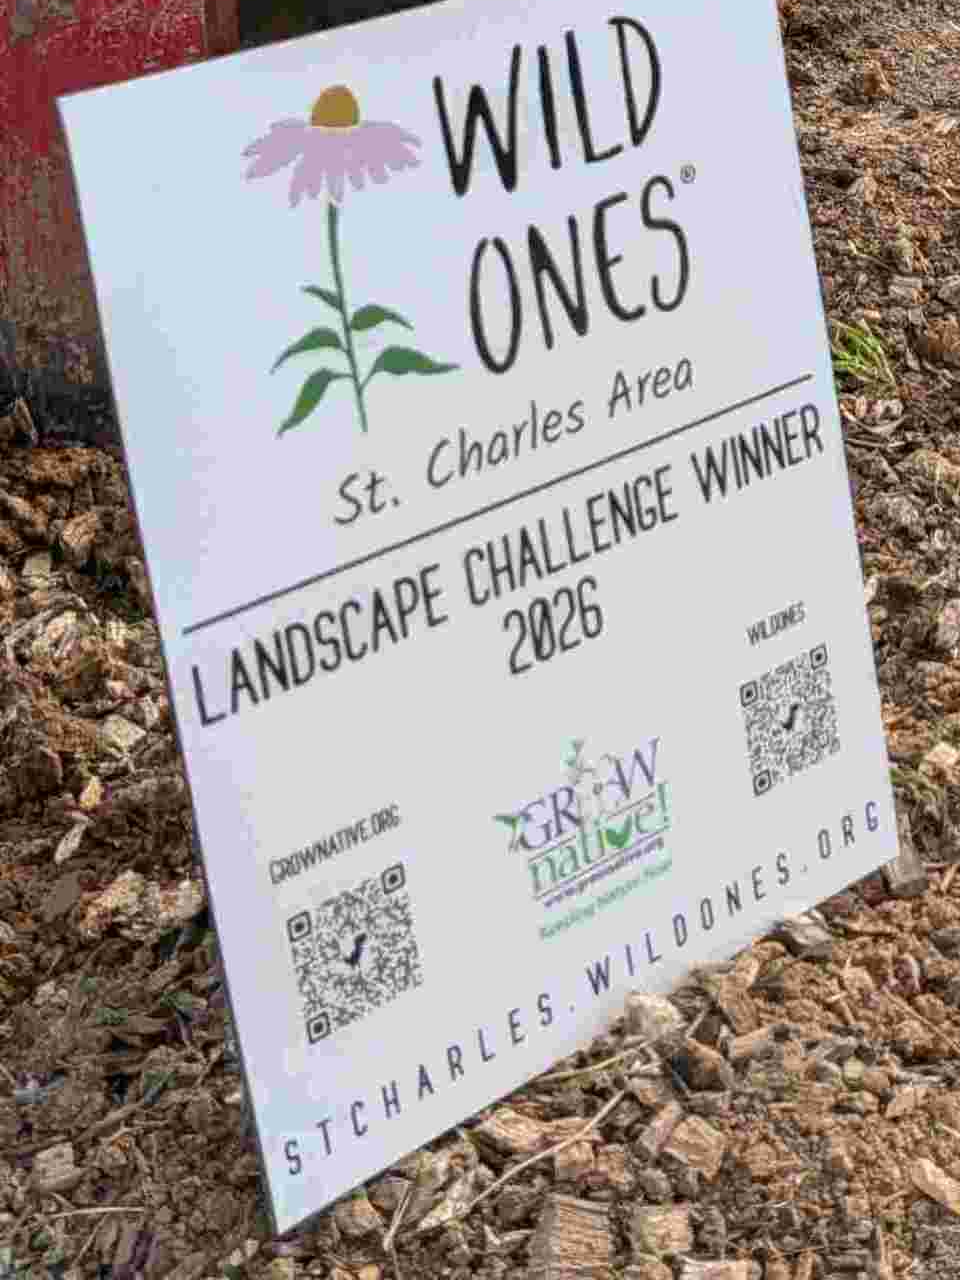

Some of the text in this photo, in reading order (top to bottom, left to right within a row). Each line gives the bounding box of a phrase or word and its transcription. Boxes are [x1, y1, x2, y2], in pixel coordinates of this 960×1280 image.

[430, 14, 664, 199] WILD
[332, 357, 694, 527] St. Charles Area
[190, 402, 825, 729] LANDSCAPE CHALLENGE WINNER
[502, 574, 605, 676] 2026
[518, 736, 662, 851] GRW
